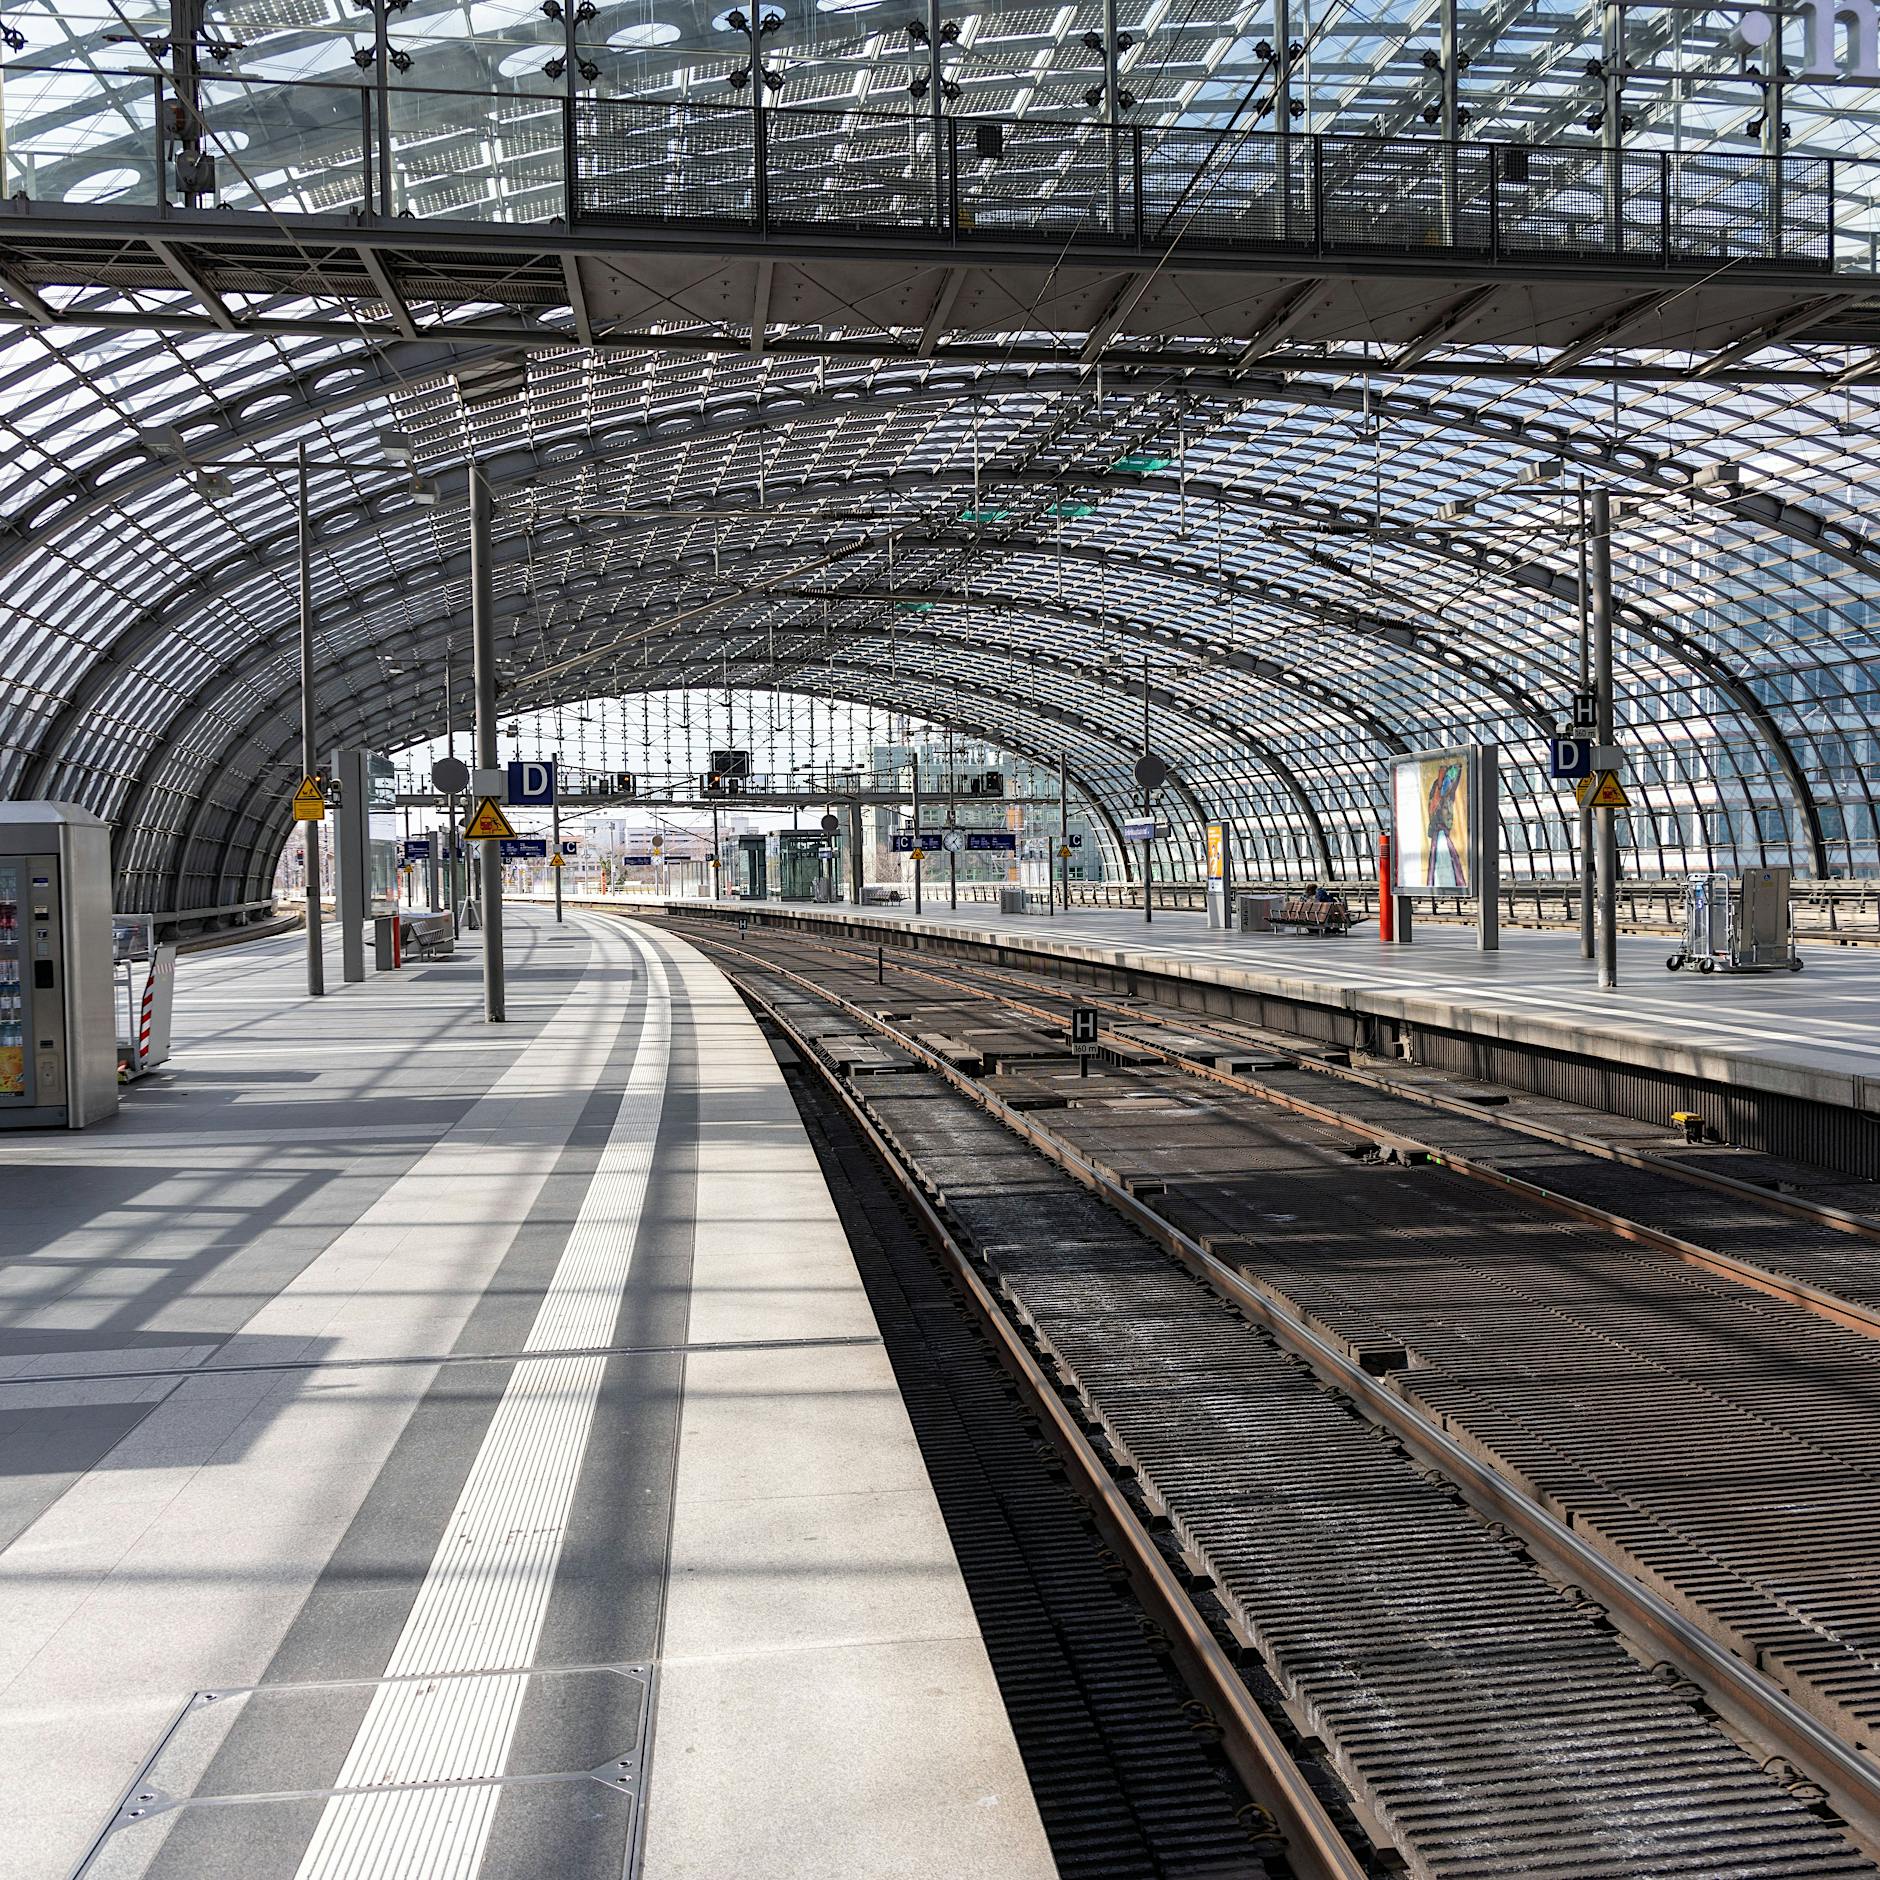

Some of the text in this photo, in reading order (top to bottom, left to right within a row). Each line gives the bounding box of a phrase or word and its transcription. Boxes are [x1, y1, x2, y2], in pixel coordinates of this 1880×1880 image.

[1577, 698, 1593, 723] H
[1558, 740, 1579, 770] D
[523, 763, 548, 796] D
[901, 836, 909, 848] C
[1072, 835, 1081, 845] C
[566, 842, 575, 853] C
[1697, 899, 1703, 909] 5
[739, 919, 747, 929] H
[1076, 1012, 1094, 1038] H
[1075, 1045, 1087, 1053] 160
